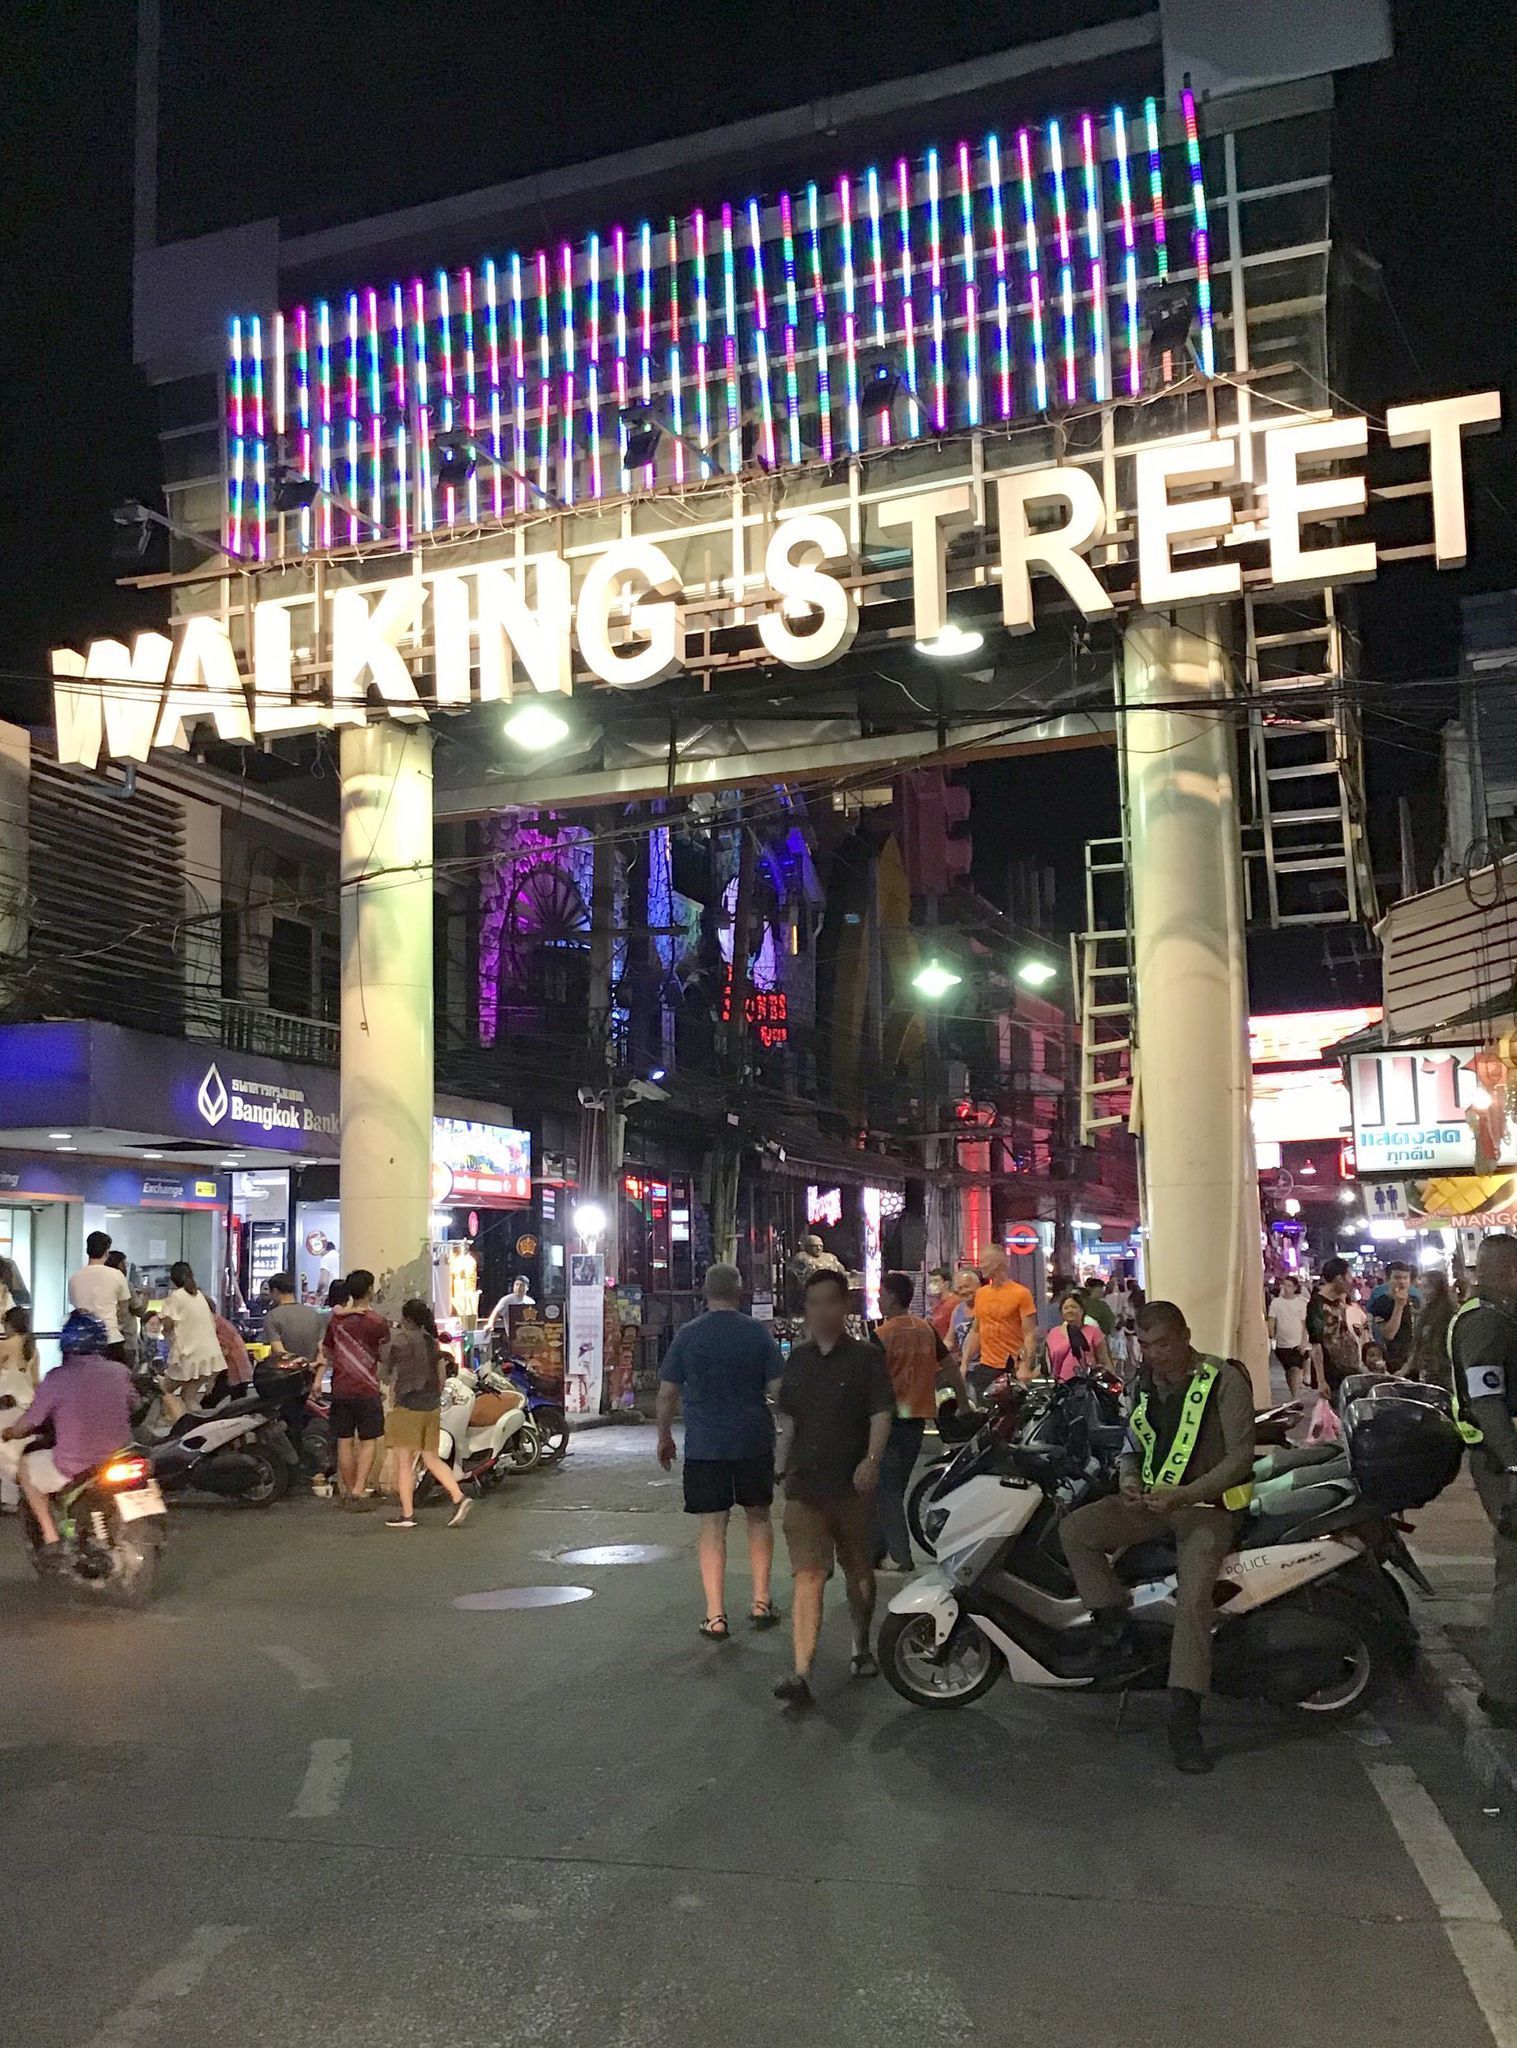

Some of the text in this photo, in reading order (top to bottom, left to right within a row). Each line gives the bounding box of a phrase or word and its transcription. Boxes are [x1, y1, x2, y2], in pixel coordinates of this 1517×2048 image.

[51, 391, 1502, 770] WALKING STREET
[231, 1096, 340, 1135] Bangkok Bank
[142, 1182, 184, 1197] Exchange
[1162, 1371, 1211, 1485] POLICE
[1225, 1554, 1271, 1576] POLICE
